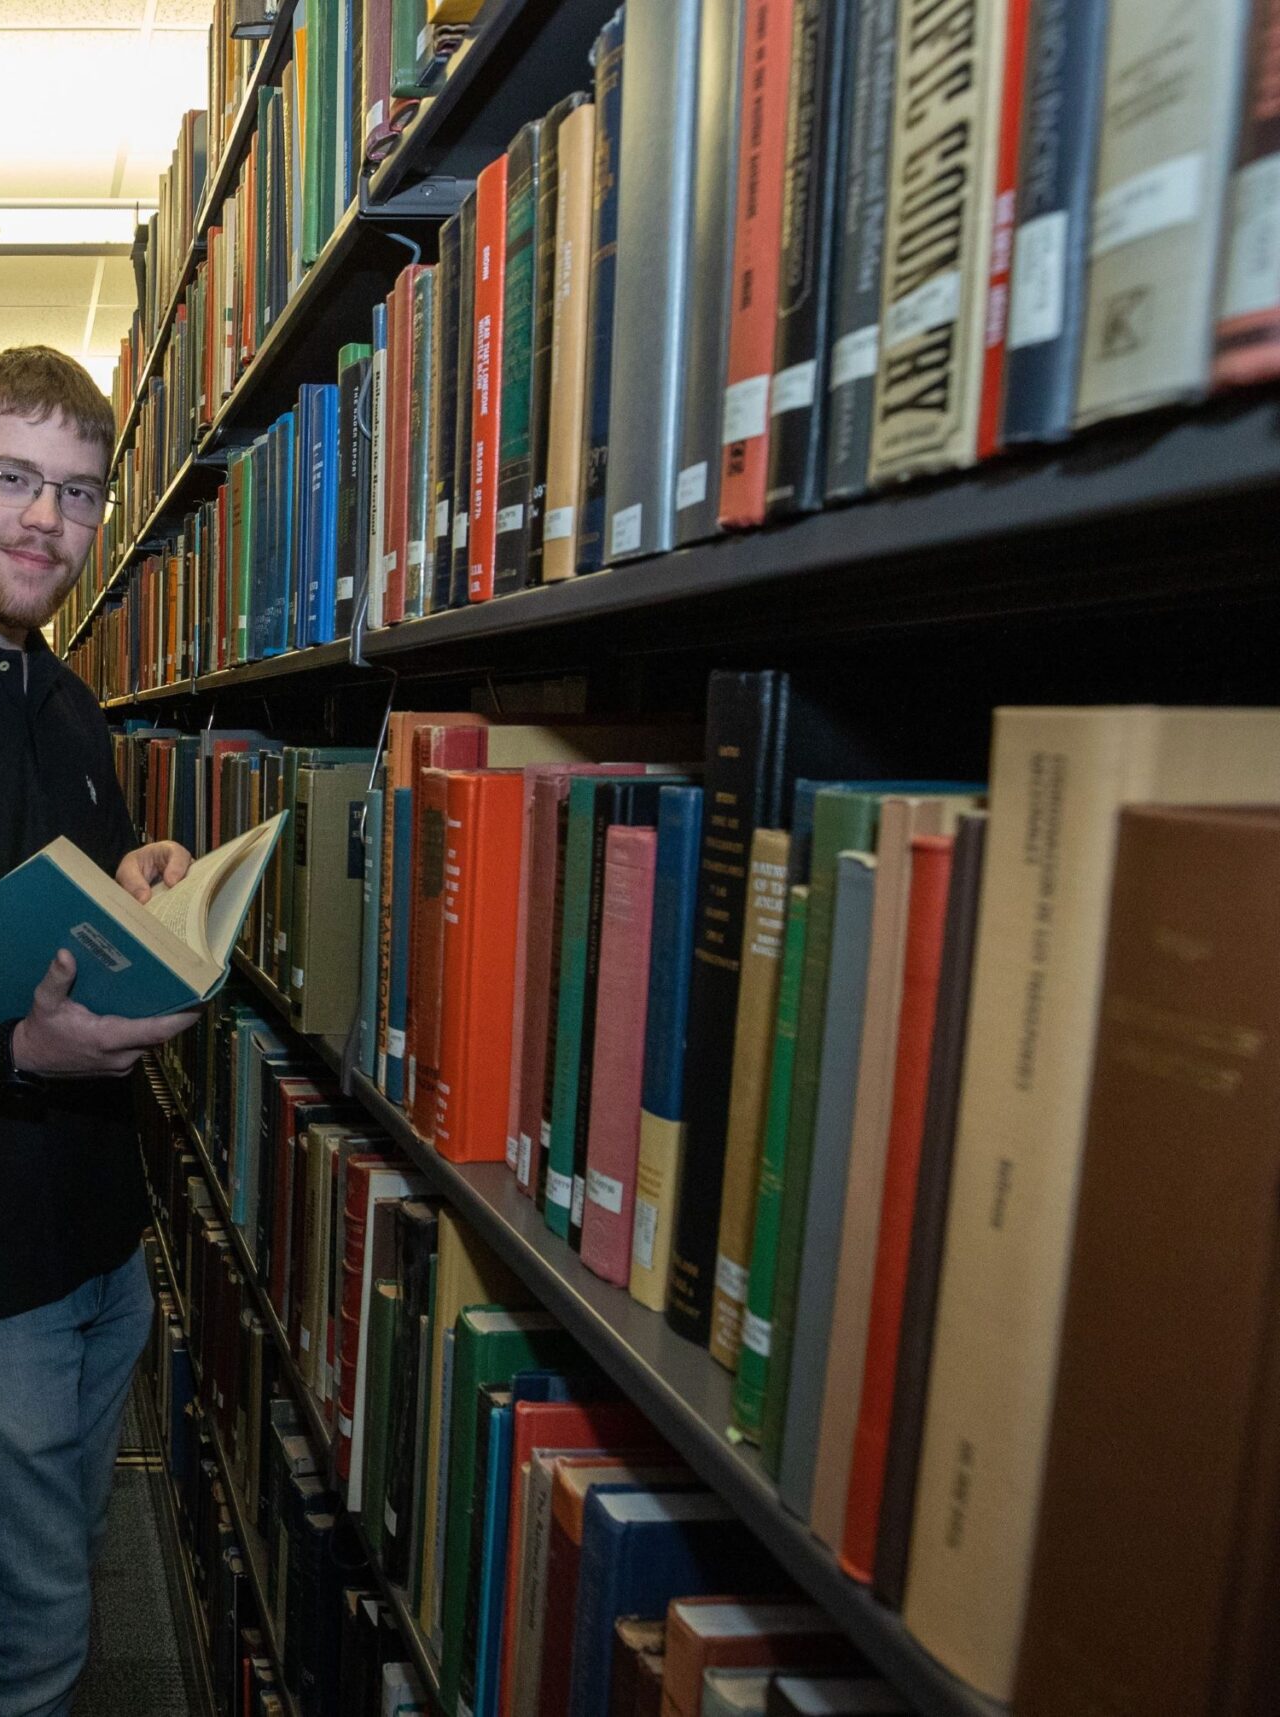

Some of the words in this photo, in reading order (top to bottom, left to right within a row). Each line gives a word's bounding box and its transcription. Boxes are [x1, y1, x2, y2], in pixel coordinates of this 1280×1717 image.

[481, 245, 491, 281] BROWN
[883, 119, 969, 422] COUNRY
[481, 315, 491, 340] HEAR
[480, 341, 490, 365] THAT
[373, 370, 382, 432] Railroads
[479, 366, 489, 416] LONESOME
[351, 408, 359, 439] NADER
[372, 434, 380, 448] in
[350, 441, 358, 478] REPORT
[371, 451, 380, 471] the
[370, 474, 378, 536] Heartland
[378, 902, 391, 1049] RAILROADS
